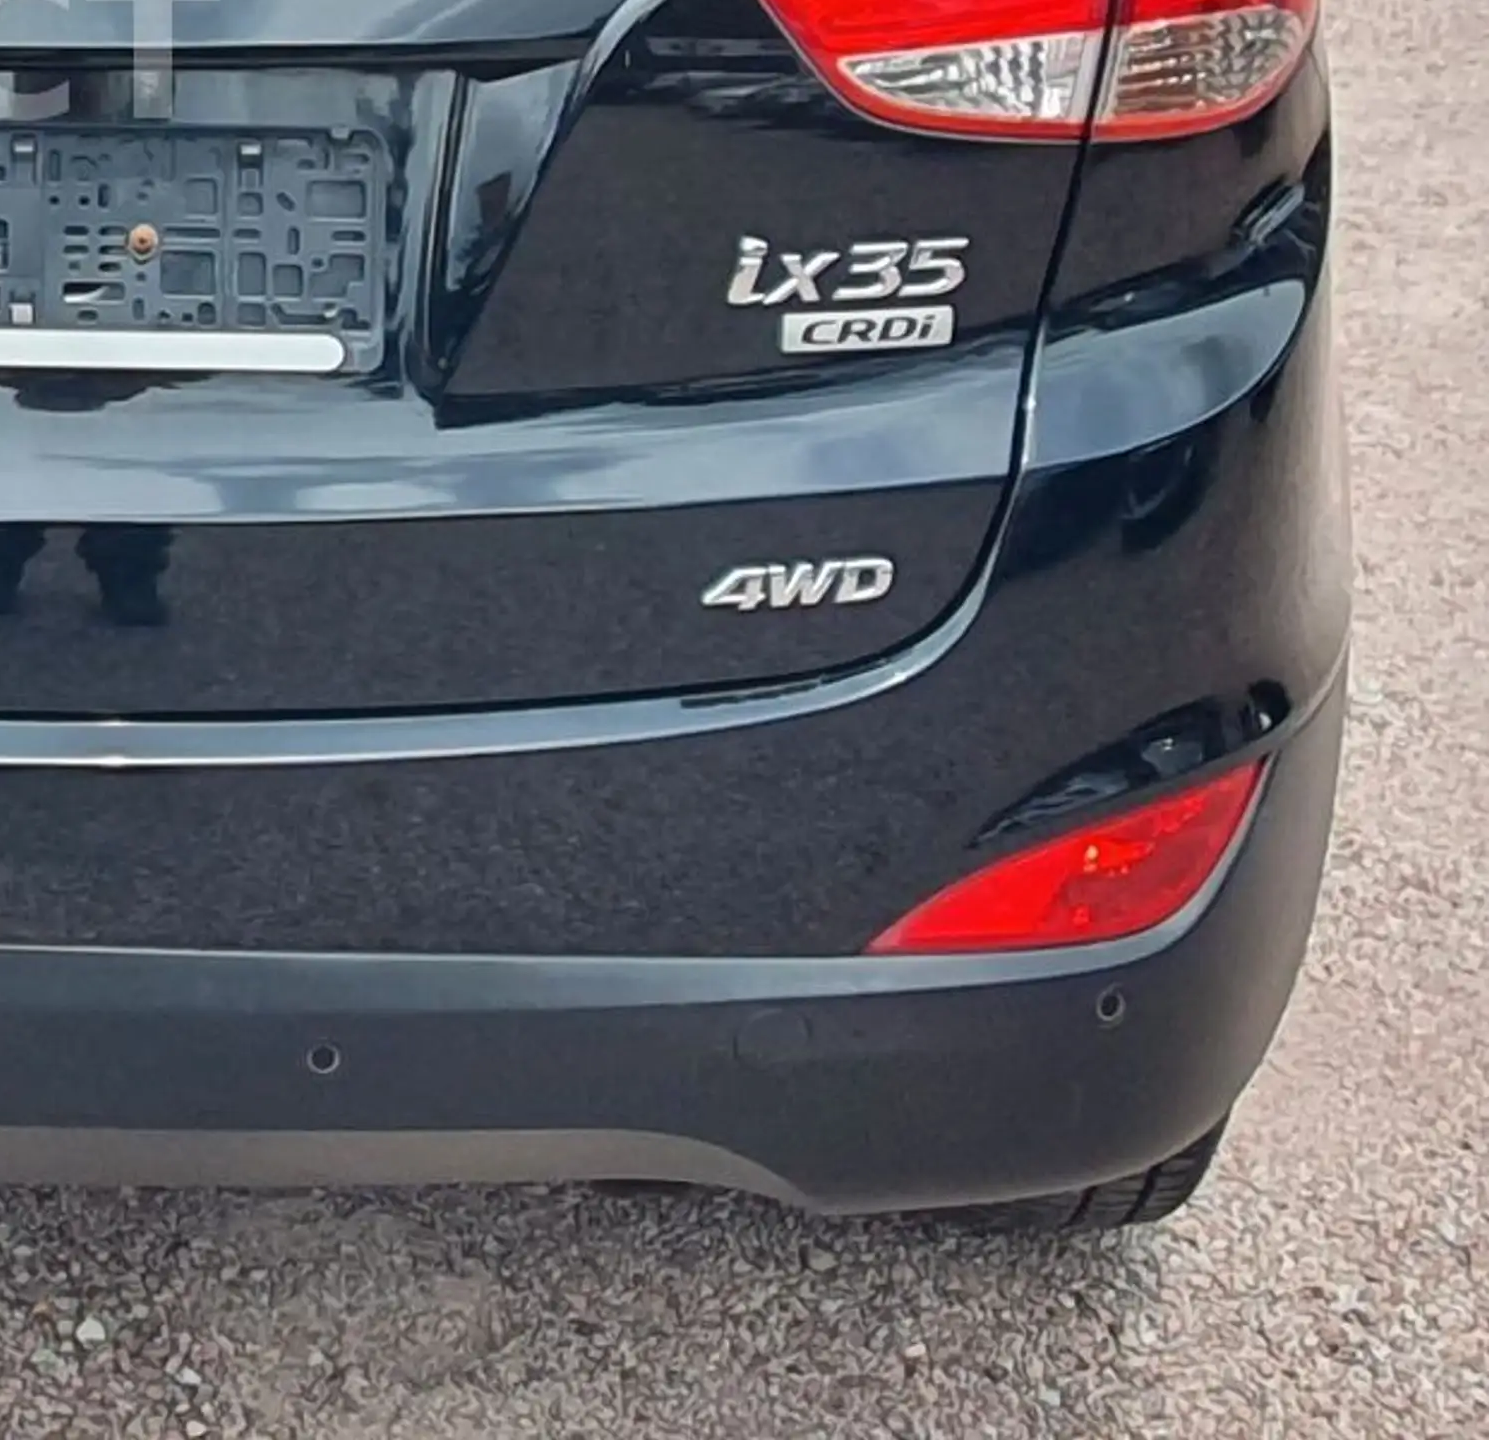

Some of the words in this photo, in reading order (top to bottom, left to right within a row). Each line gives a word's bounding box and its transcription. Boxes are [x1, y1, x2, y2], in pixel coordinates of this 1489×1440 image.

[727, 235, 971, 306] ix35
[801, 314, 937, 345] CRDi
[701, 556, 895, 612] 4WD
